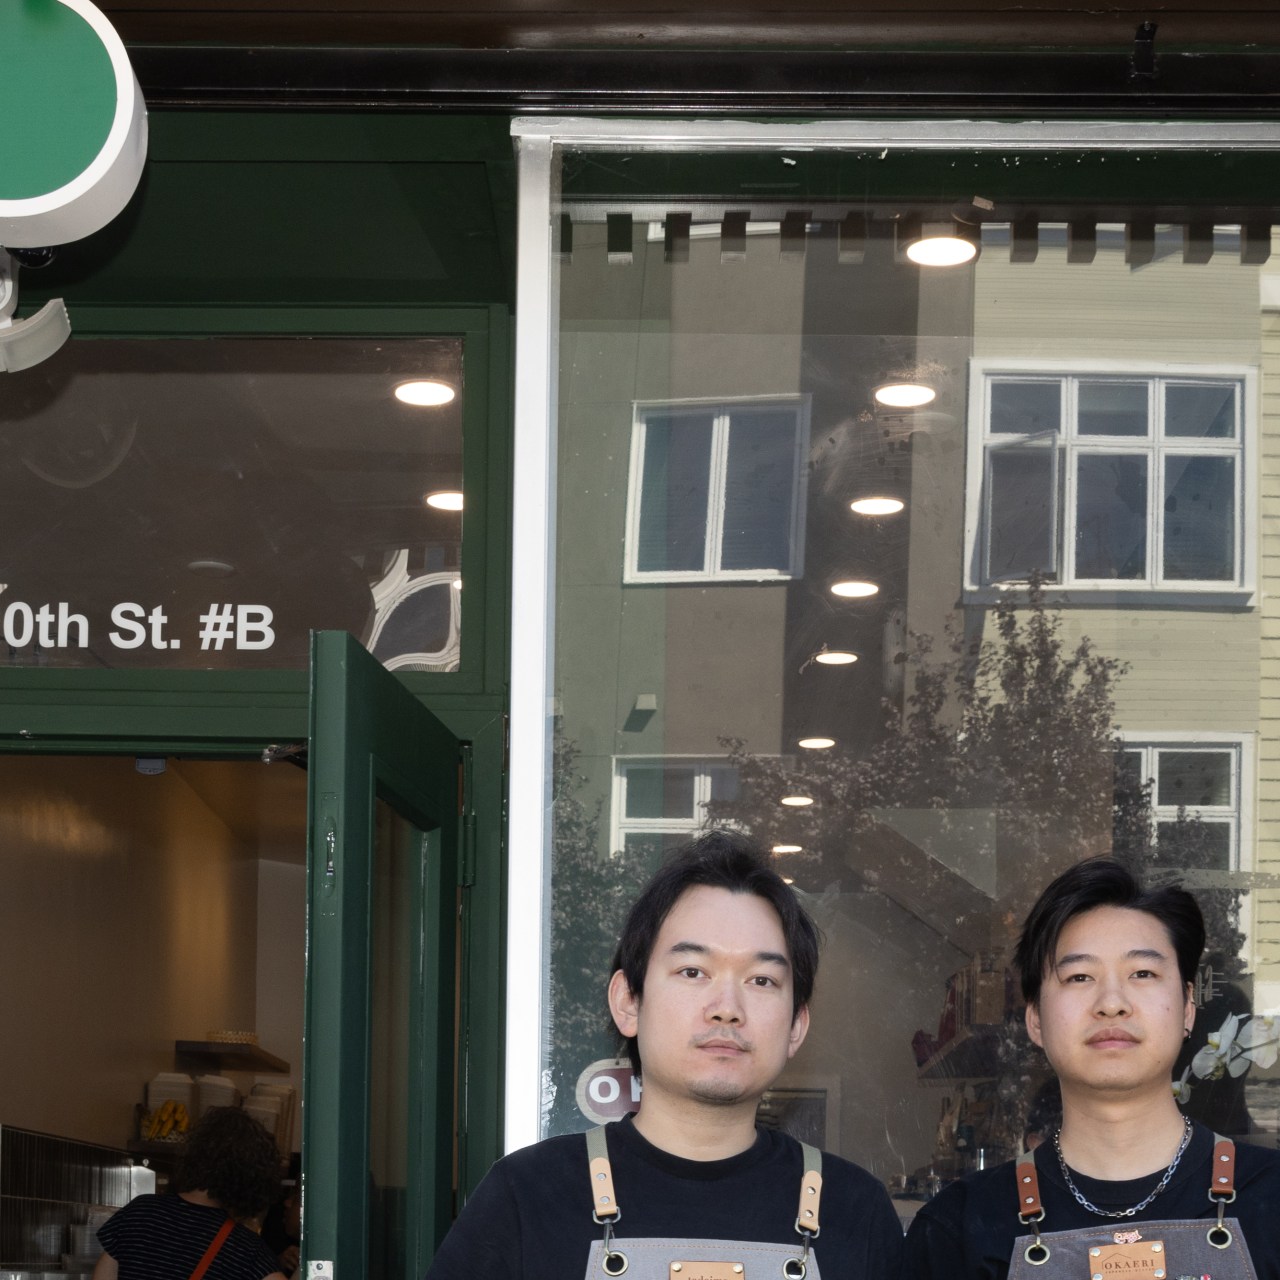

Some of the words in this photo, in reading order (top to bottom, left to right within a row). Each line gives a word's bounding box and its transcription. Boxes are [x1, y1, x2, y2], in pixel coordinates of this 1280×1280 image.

[108, 602, 182, 651] St.
[199, 603, 276, 651] #B
[1104, 1259, 1155, 1270] OKAERI
